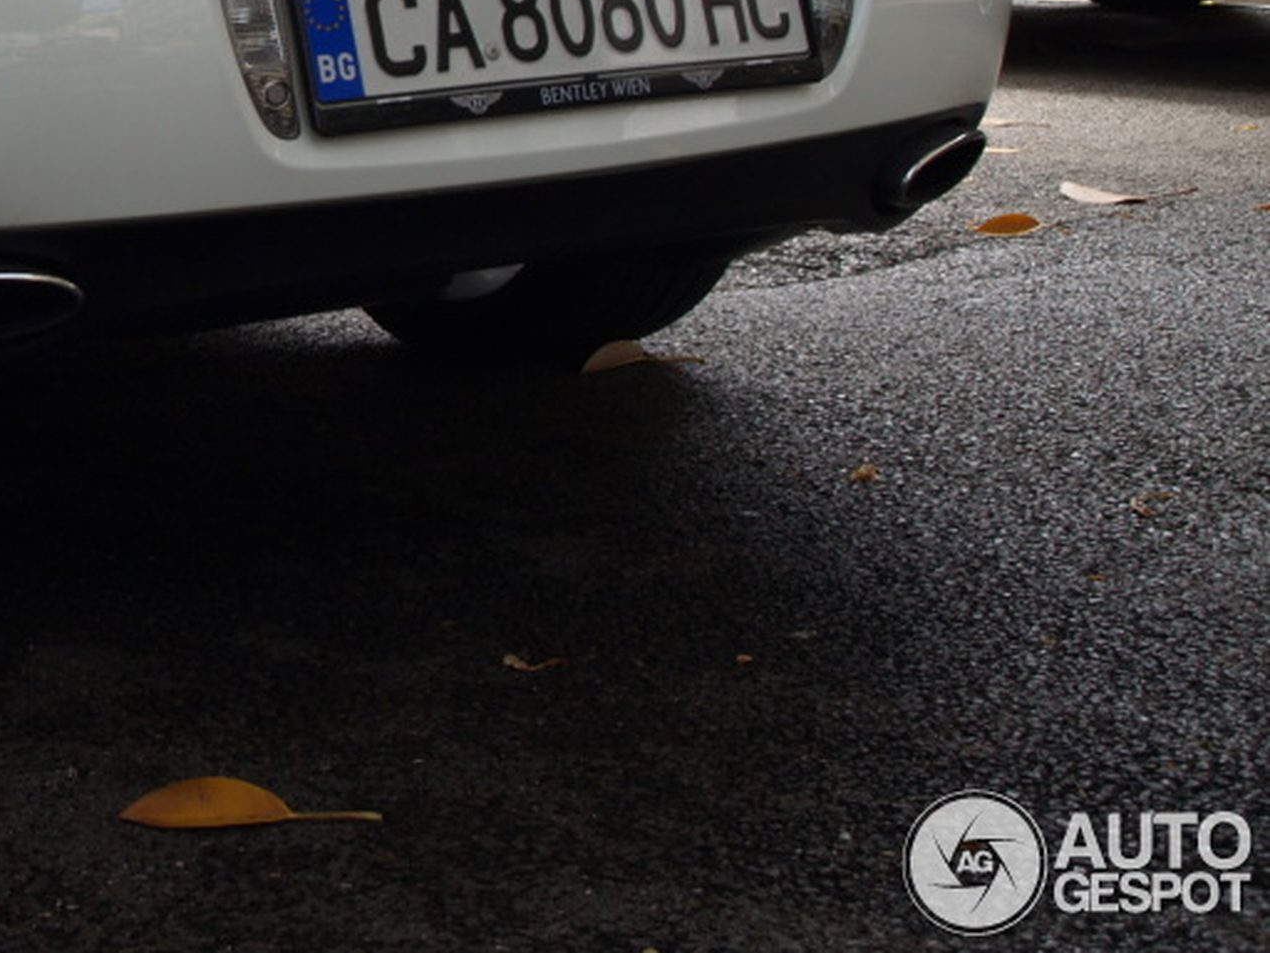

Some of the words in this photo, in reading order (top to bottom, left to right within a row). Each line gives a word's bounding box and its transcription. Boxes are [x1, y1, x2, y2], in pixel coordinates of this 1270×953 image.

[317, 52, 357, 83] BG
[540, 81, 608, 106] BENTLEY
[611, 77, 651, 96] WIEN
